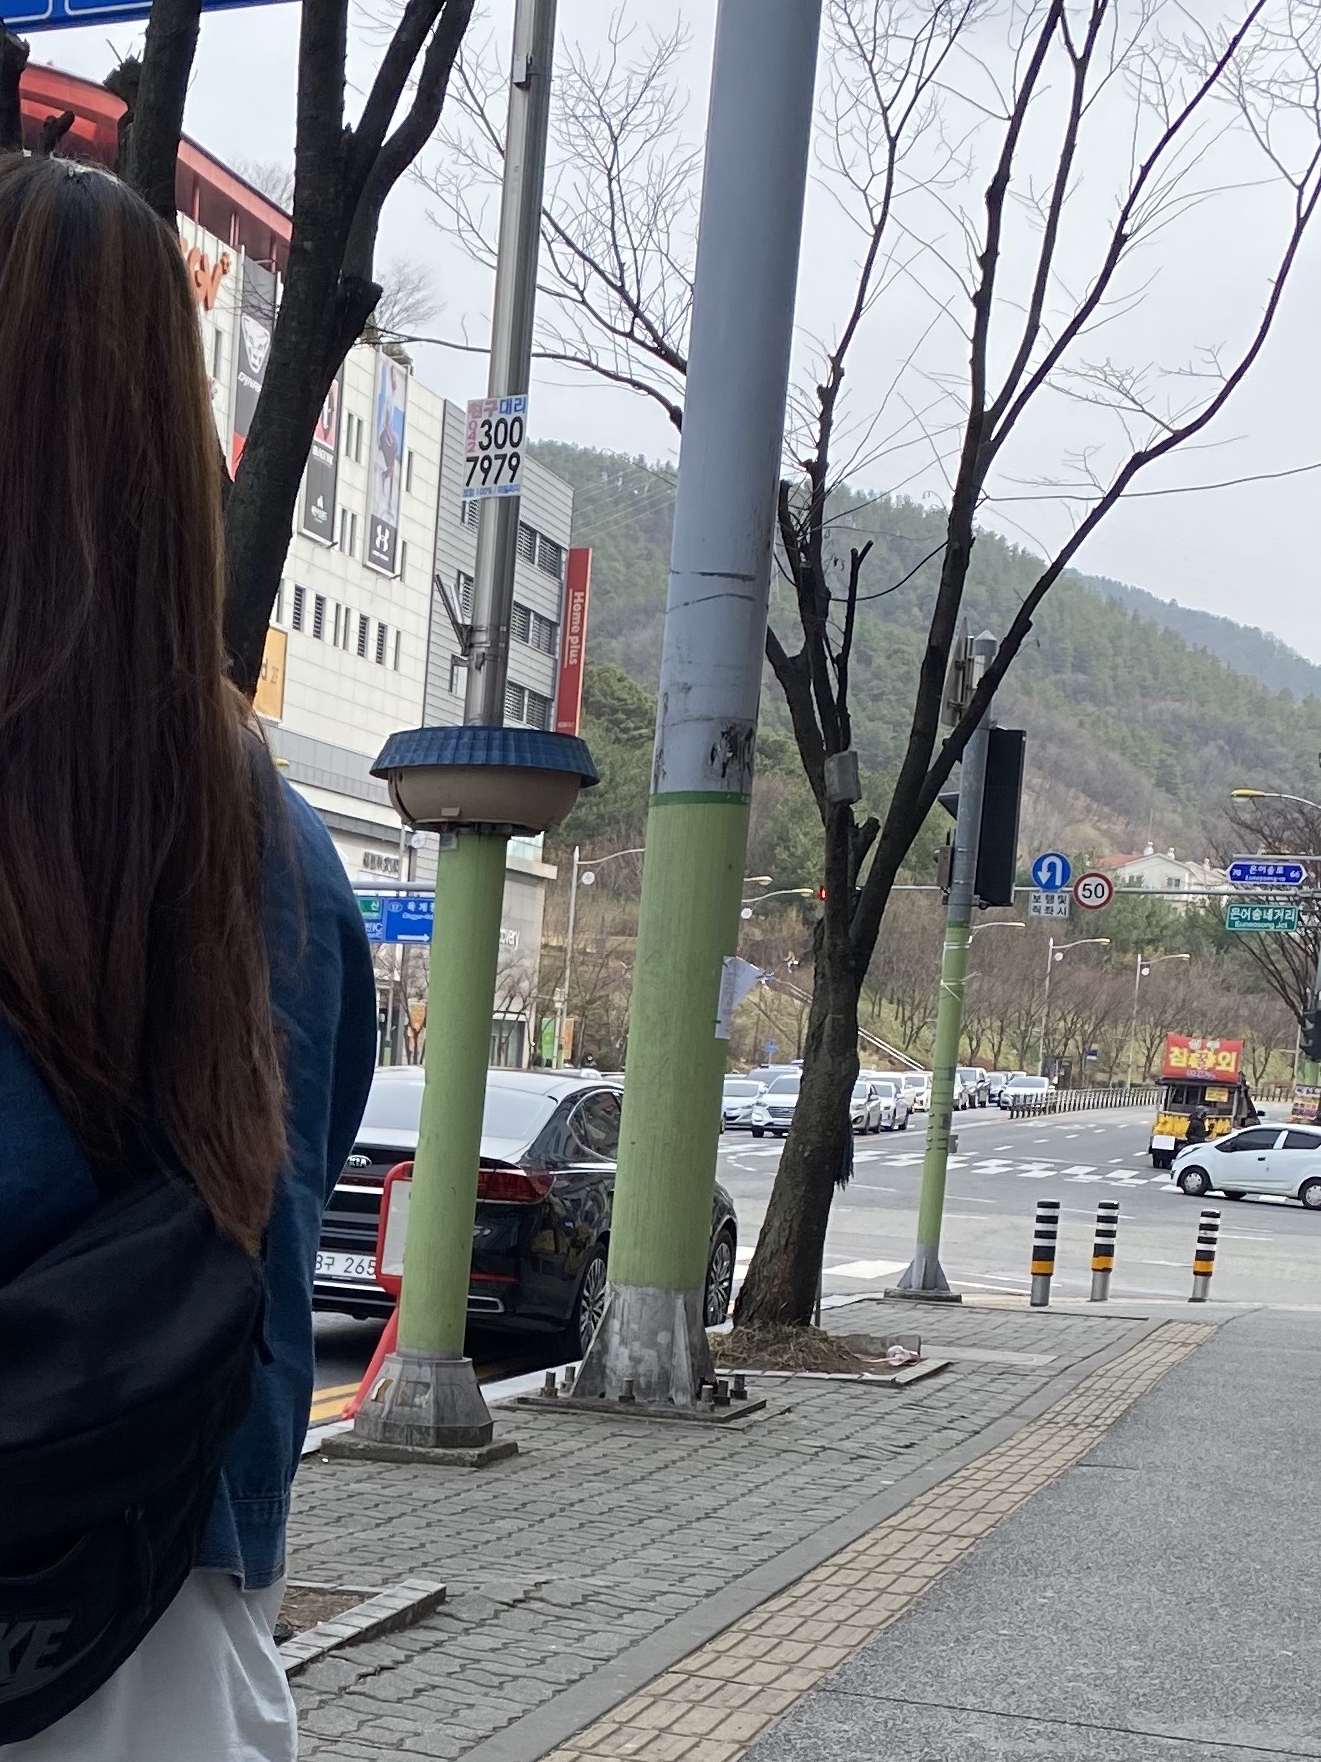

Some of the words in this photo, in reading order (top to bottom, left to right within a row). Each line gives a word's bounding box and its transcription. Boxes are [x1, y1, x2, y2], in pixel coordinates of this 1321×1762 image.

[478, 415, 524, 451] 300
[465, 451, 521, 488] 7979
[571, 591, 585, 634] Home
[569, 635, 581, 666] plus
[1082, 883, 1105, 898] 50
[1230, 907, 1295, 921] 은어송네거리
[349, 1156, 368, 1168] KIA
